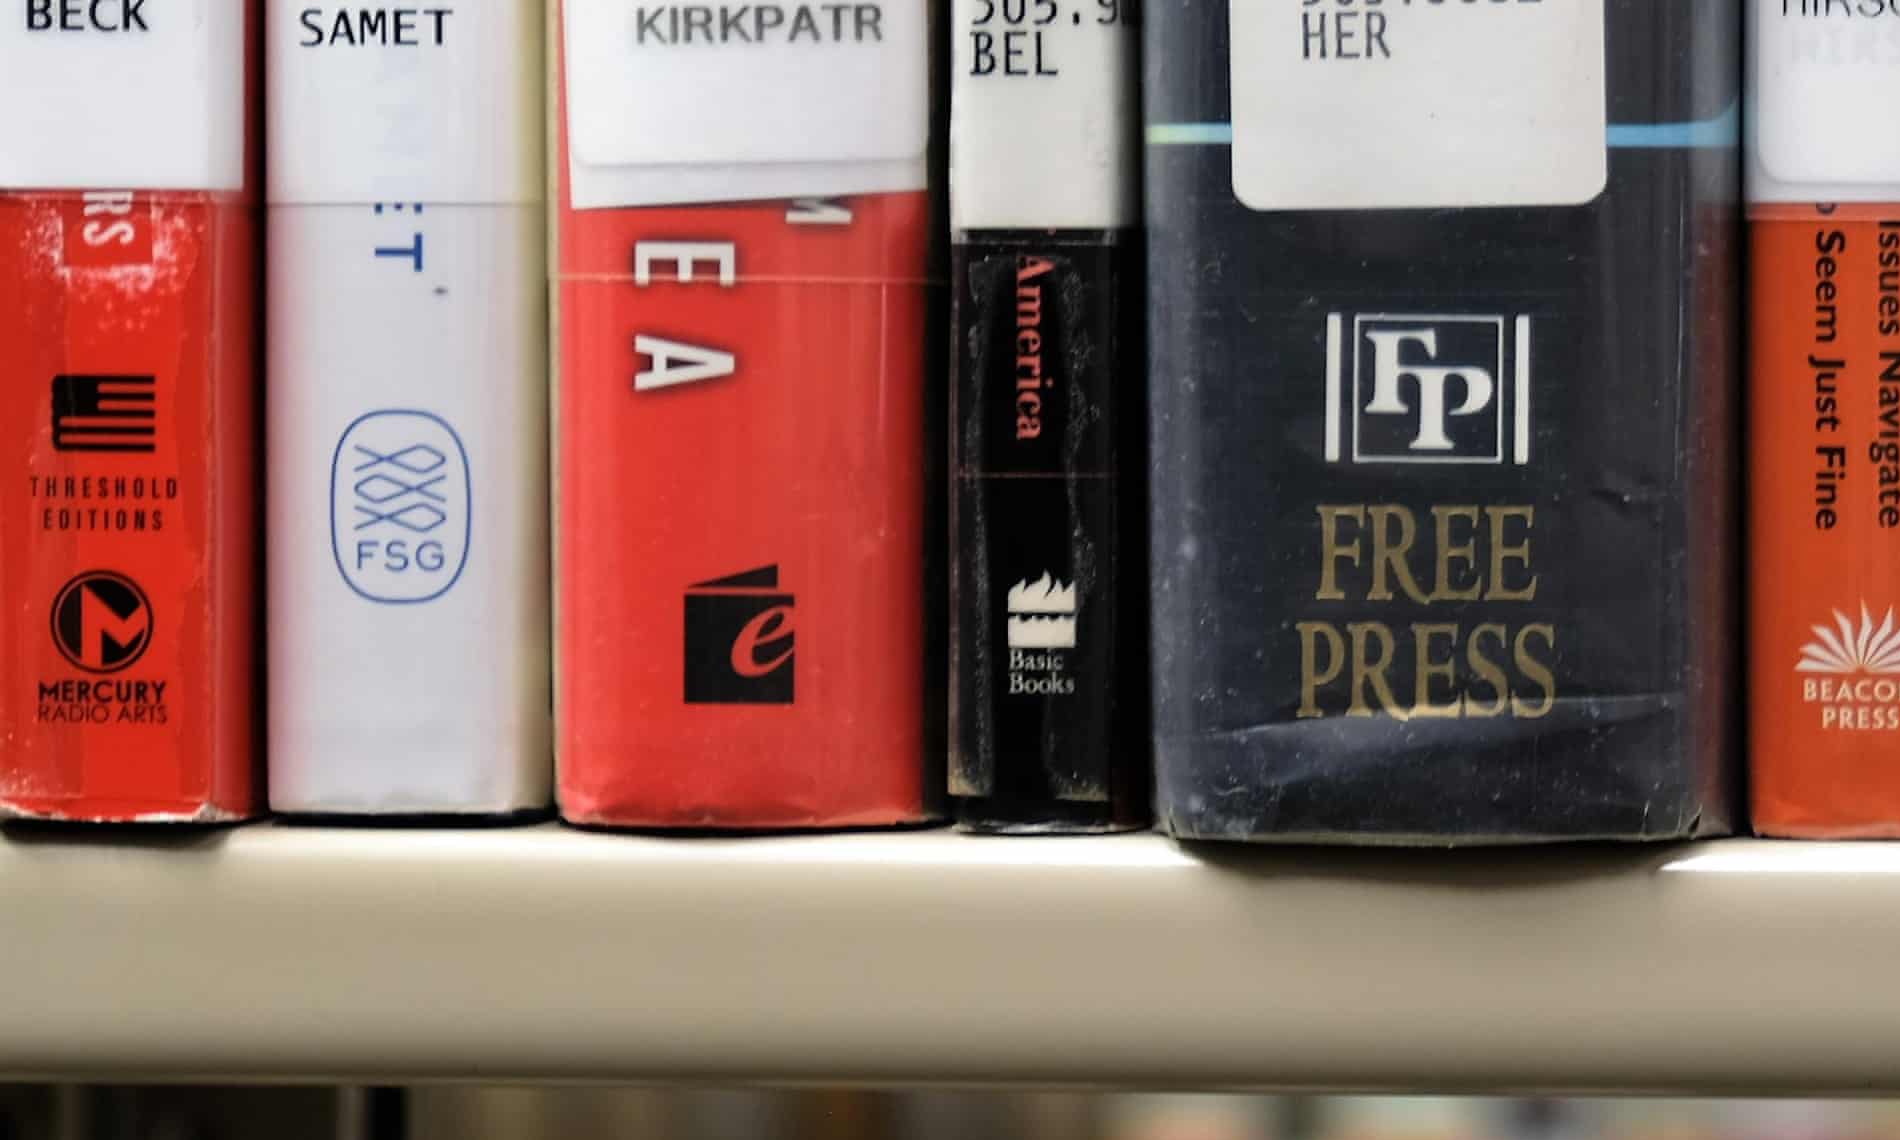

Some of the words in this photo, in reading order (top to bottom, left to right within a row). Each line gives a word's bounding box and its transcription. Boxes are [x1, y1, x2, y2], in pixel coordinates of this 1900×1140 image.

[27, 0, 147, 31] BECK
[301, 10, 451, 46] SAMET
[635, 4, 882, 44] KIRKPATR
[971, 32, 1057, 75] BEL
[1303, 12, 1390, 59] HER
[1816, 231, 1845, 342] Seem
[1017, 256, 1054, 438] America
[1808, 355, 1845, 432] Just
[30, 477, 176, 499] THRESHOLD
[1816, 446, 1845, 529] Fine
[44, 509, 161, 530] EDITIONS
[357, 541, 444, 571] FSG
[1316, 504, 1536, 605] FREE
[1009, 649, 1063, 671] Basic
[1296, 623, 1555, 722] PRESS
[39, 681, 166, 703] MERCURY
[1010, 672, 1074, 693] Books
[39, 704, 110, 724] RADIO
[117, 704, 167, 724] ARTS
[1822, 707, 1900, 730] PRESS
